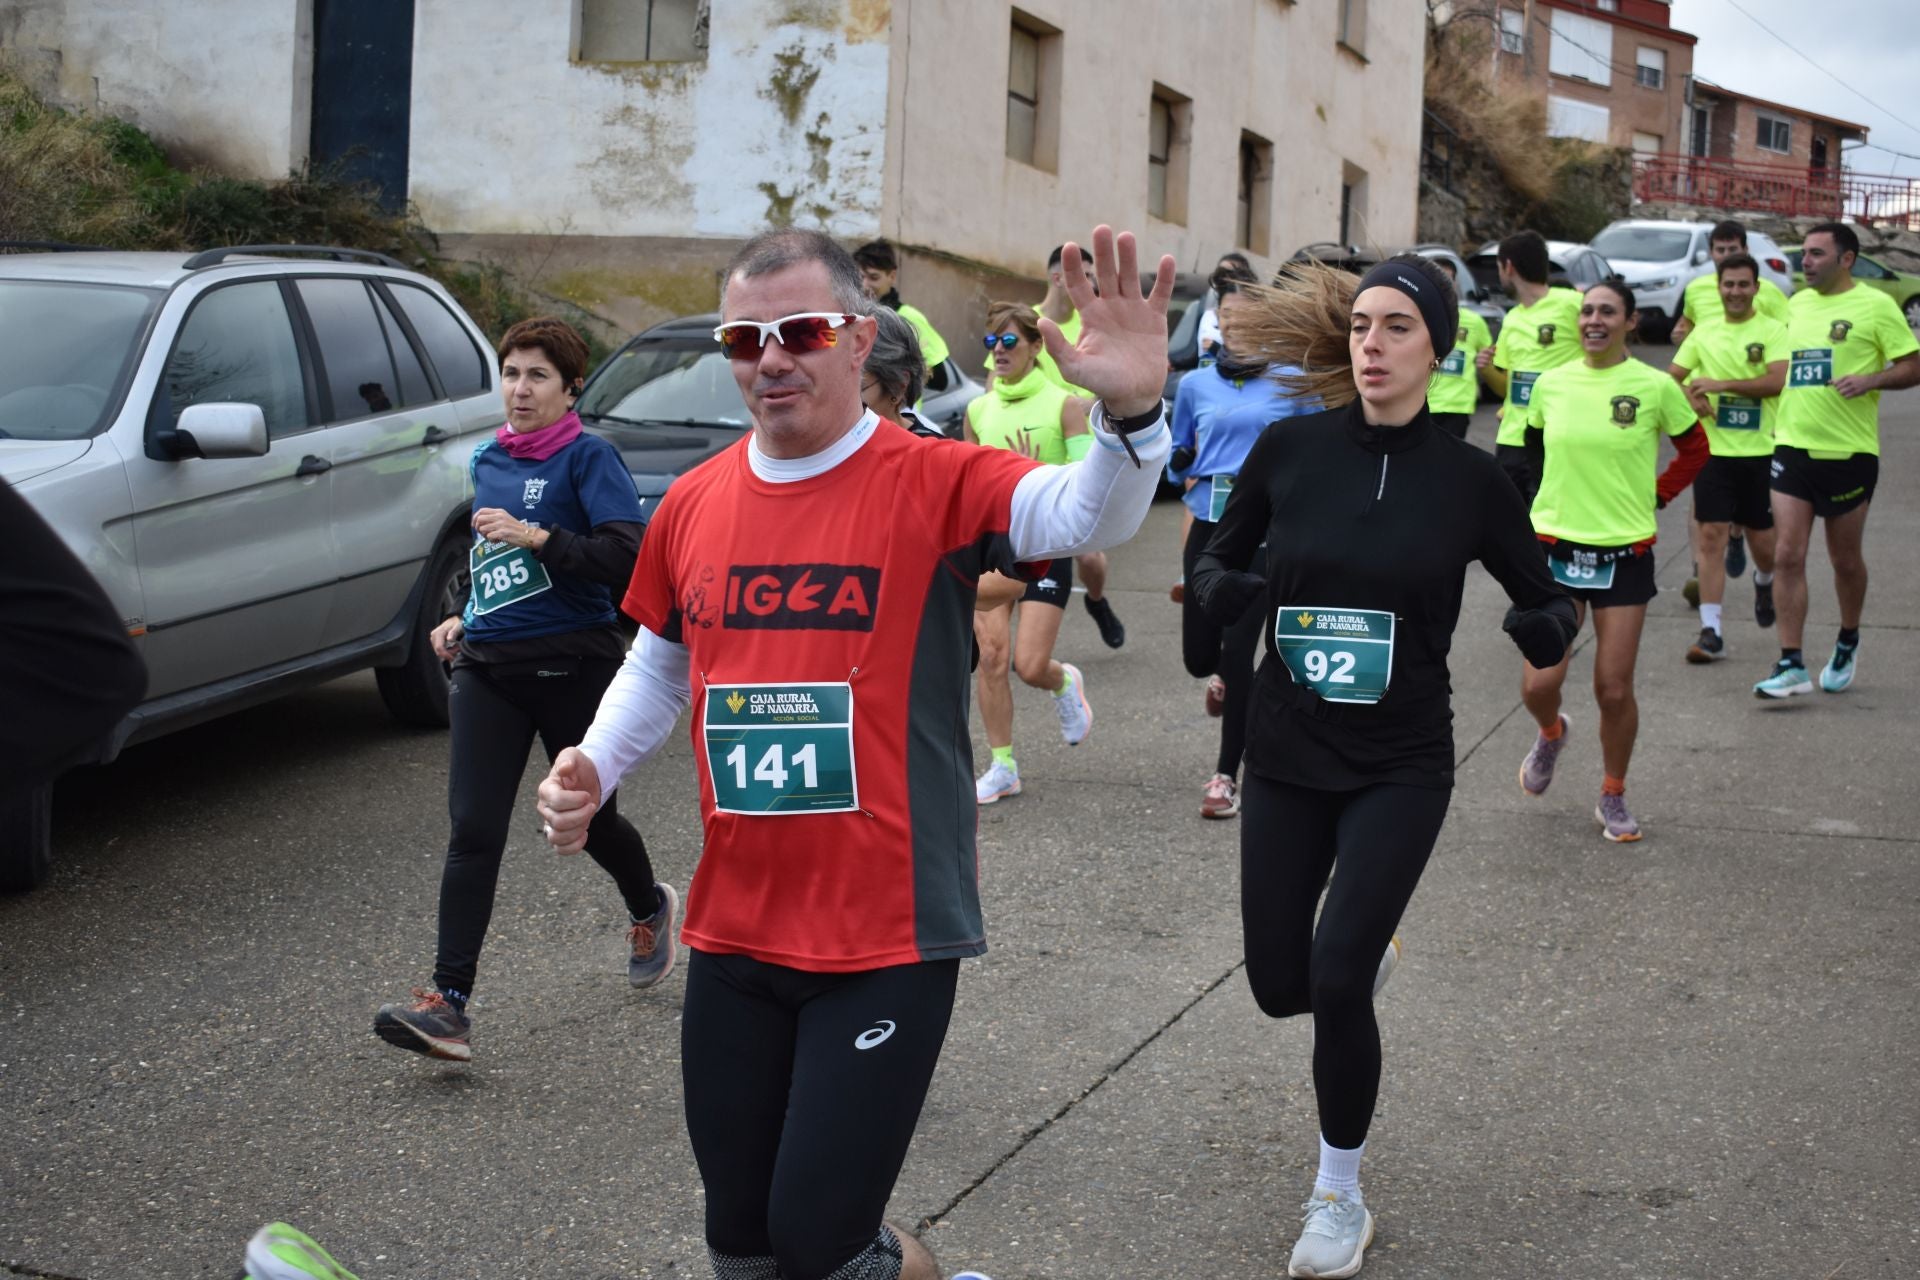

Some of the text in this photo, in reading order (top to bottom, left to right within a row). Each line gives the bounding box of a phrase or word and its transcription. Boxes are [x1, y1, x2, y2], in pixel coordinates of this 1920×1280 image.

[1794, 364, 1823, 381] 131
[1728, 410, 1749, 425] 39
[479, 557, 530, 600] 285
[1316, 621, 1369, 632] DE NAVARRA
[1317, 614, 1366, 624] CAJA RURAL
[1304, 649, 1356, 684] 92
[750, 692, 815, 705] CAJA RURAL
[750, 703, 820, 714] DE NAVARRA
[726, 743, 819, 789] 141
